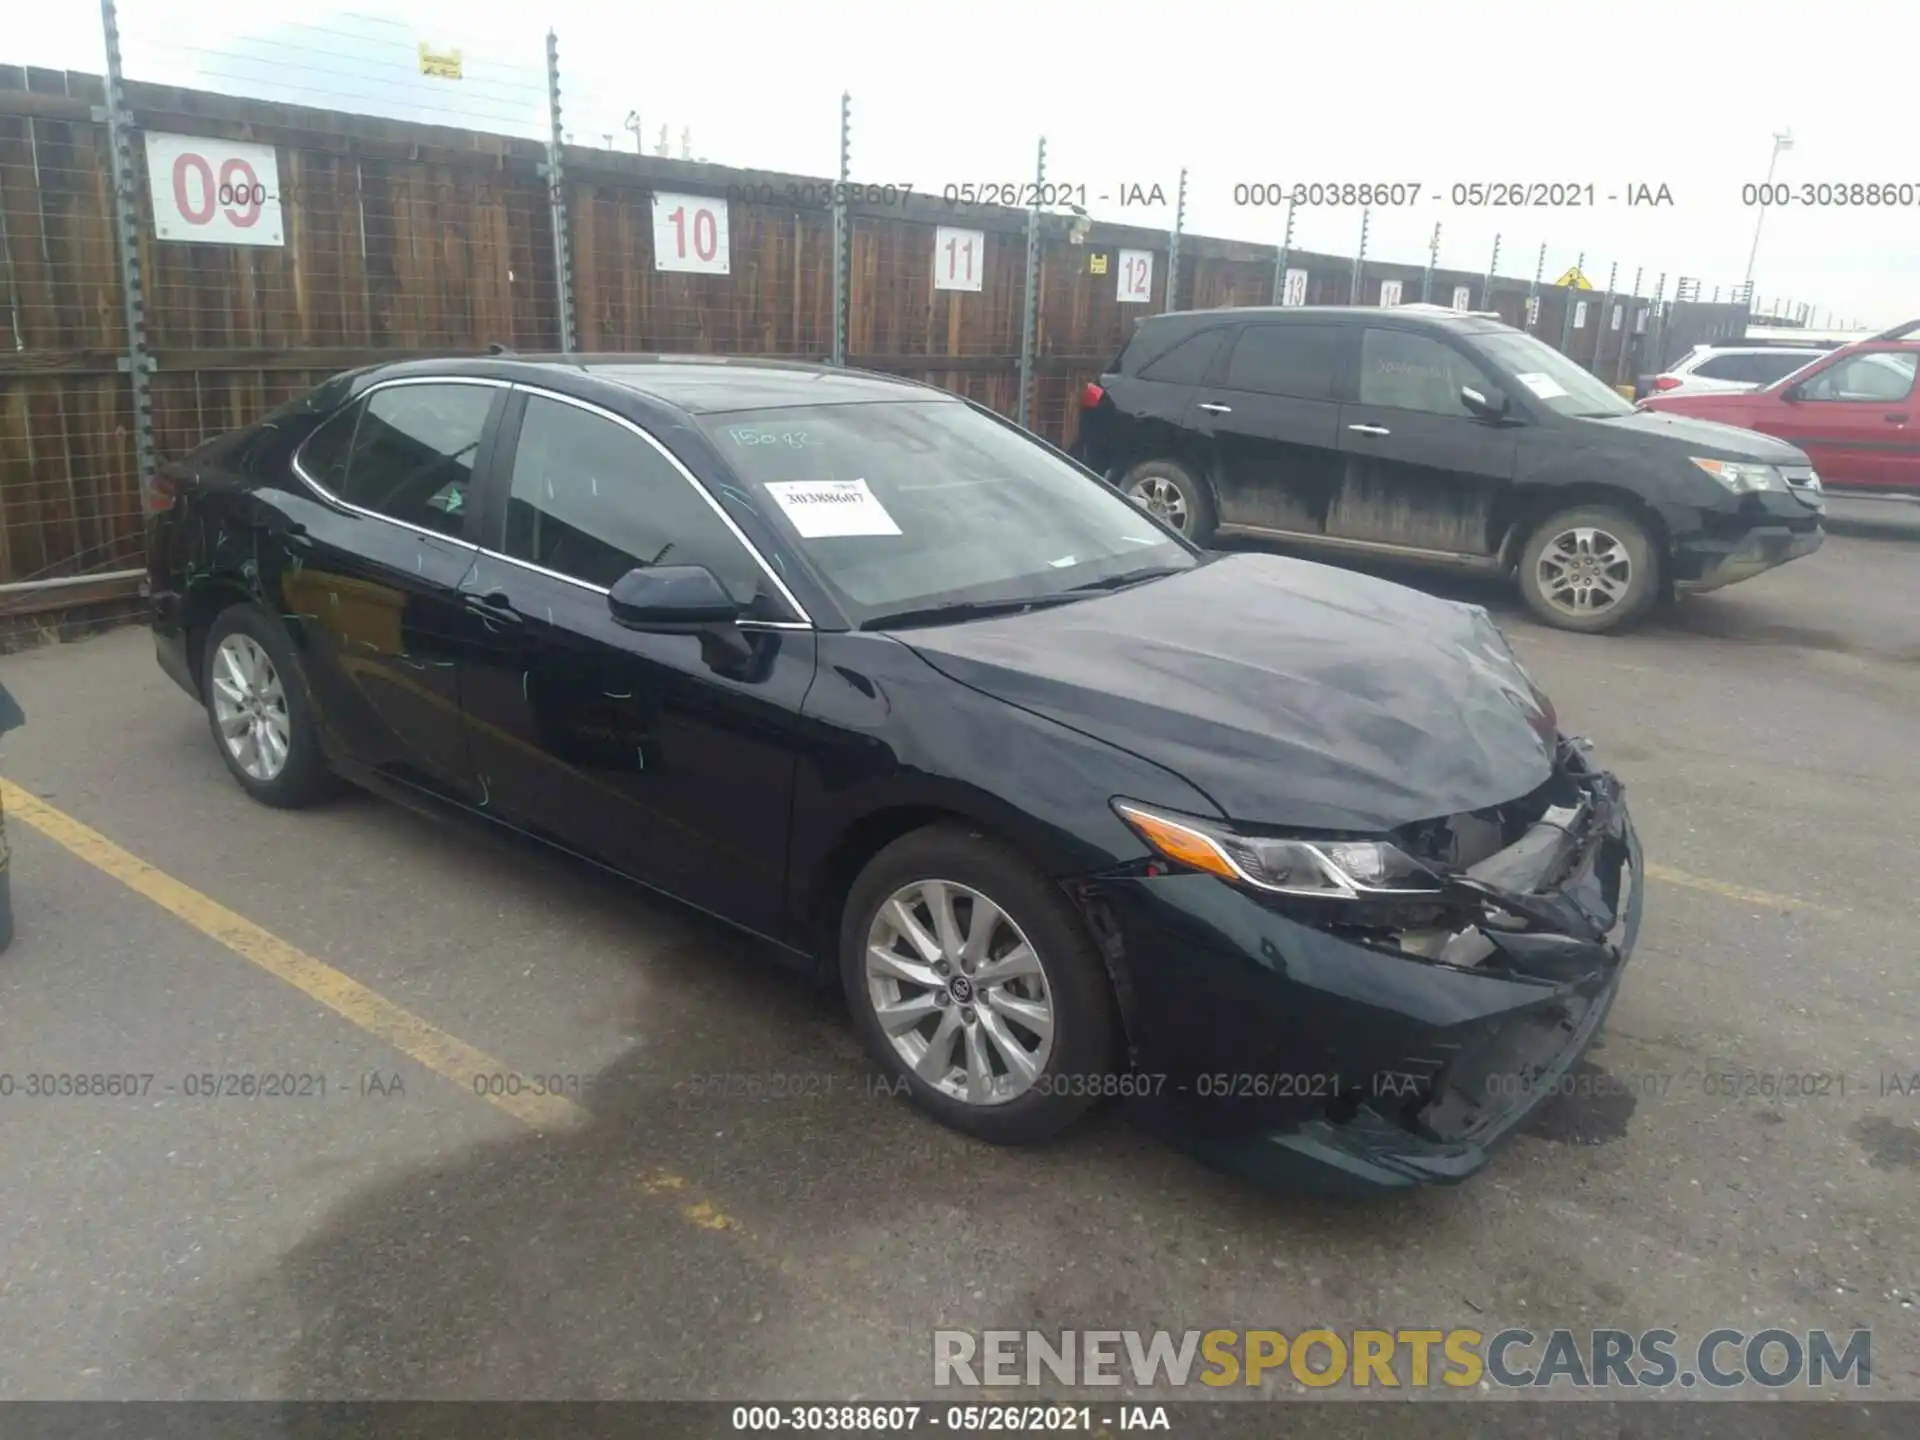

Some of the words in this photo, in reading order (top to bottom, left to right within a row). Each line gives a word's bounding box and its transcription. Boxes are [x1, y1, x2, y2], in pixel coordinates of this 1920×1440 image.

[173, 152, 261, 228] 09
[668, 206, 717, 262] 10
[945, 238, 974, 281] 11
[1125, 257, 1147, 294] 12
[786, 491, 864, 504] 30388607
